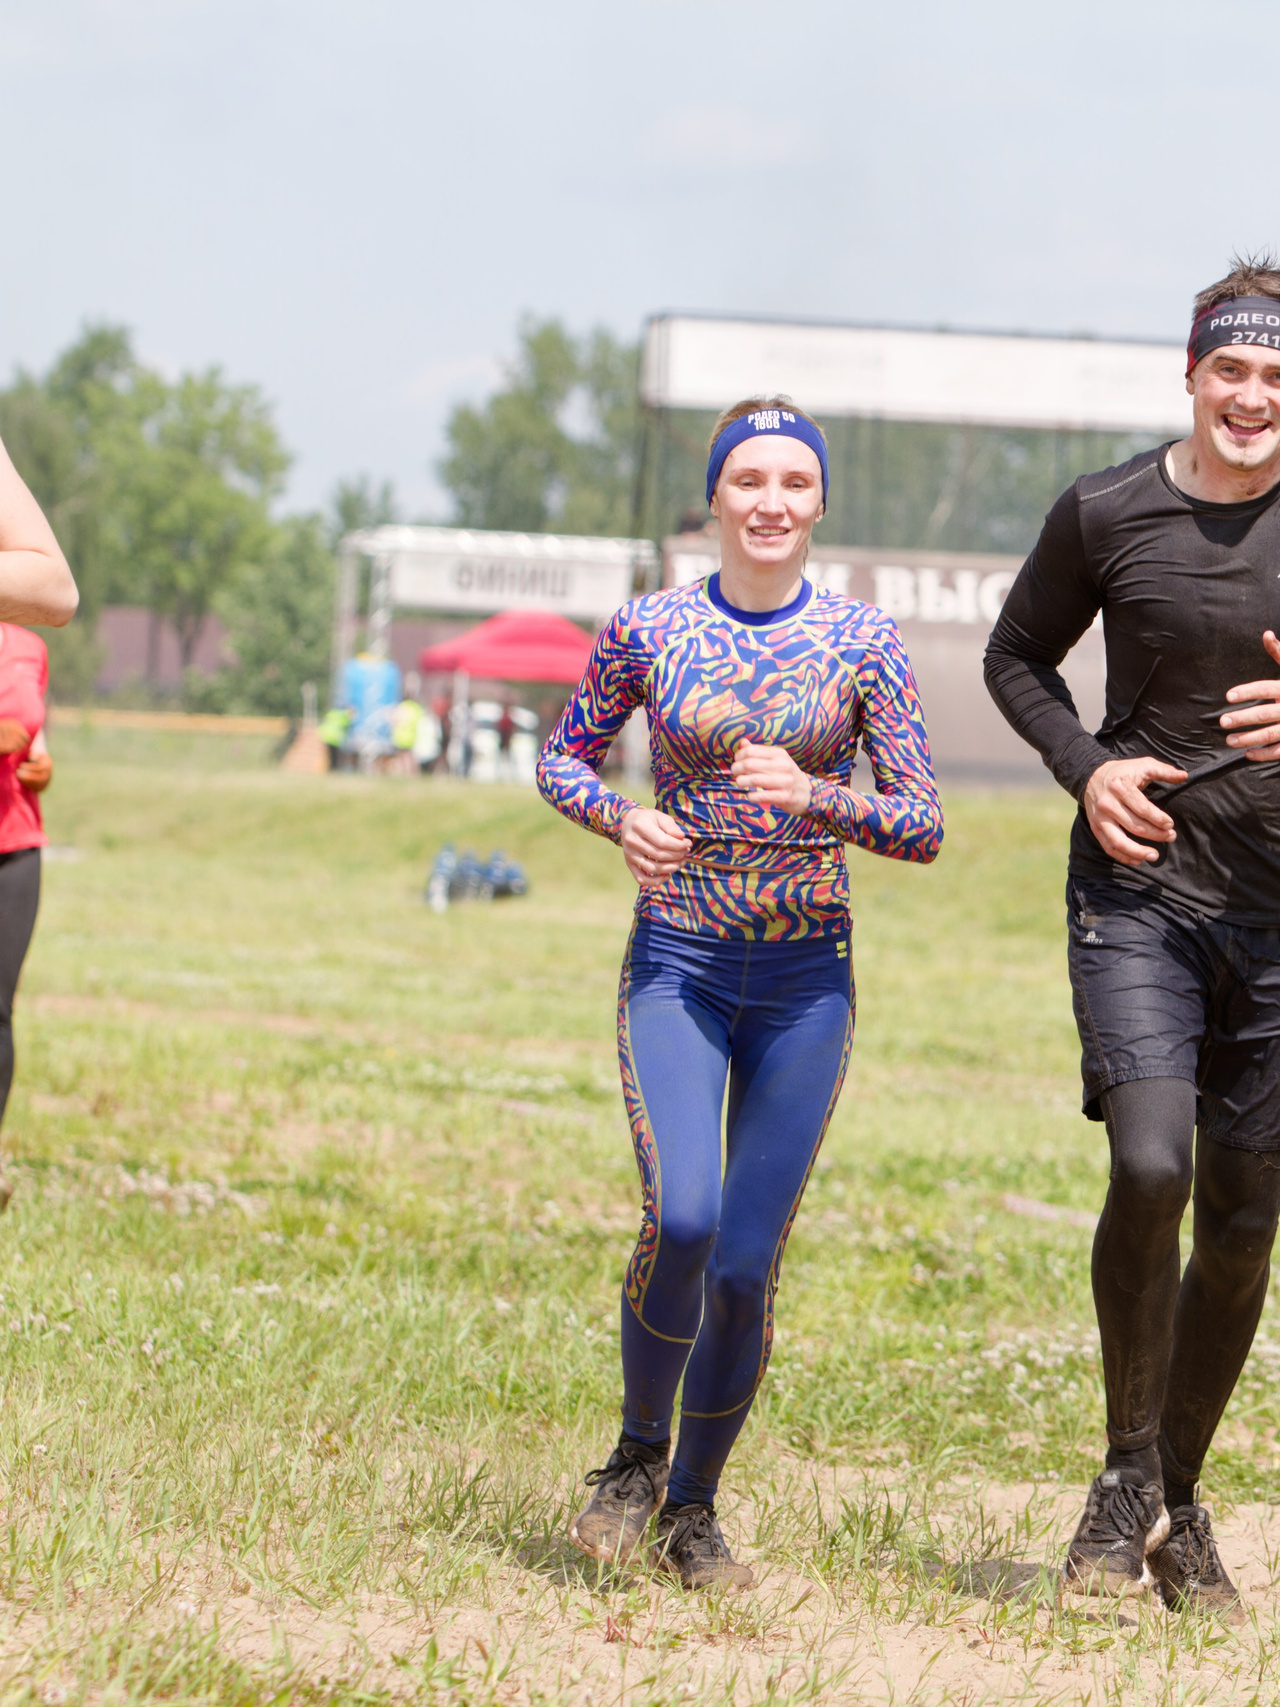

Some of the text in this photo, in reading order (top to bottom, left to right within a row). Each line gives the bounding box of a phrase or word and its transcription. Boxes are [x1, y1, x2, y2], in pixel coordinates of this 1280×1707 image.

[1210, 312, 1280, 331] РОДЕО
[1231, 331, 1280, 348] 2741
[747, 410, 780, 424] РОДЕО
